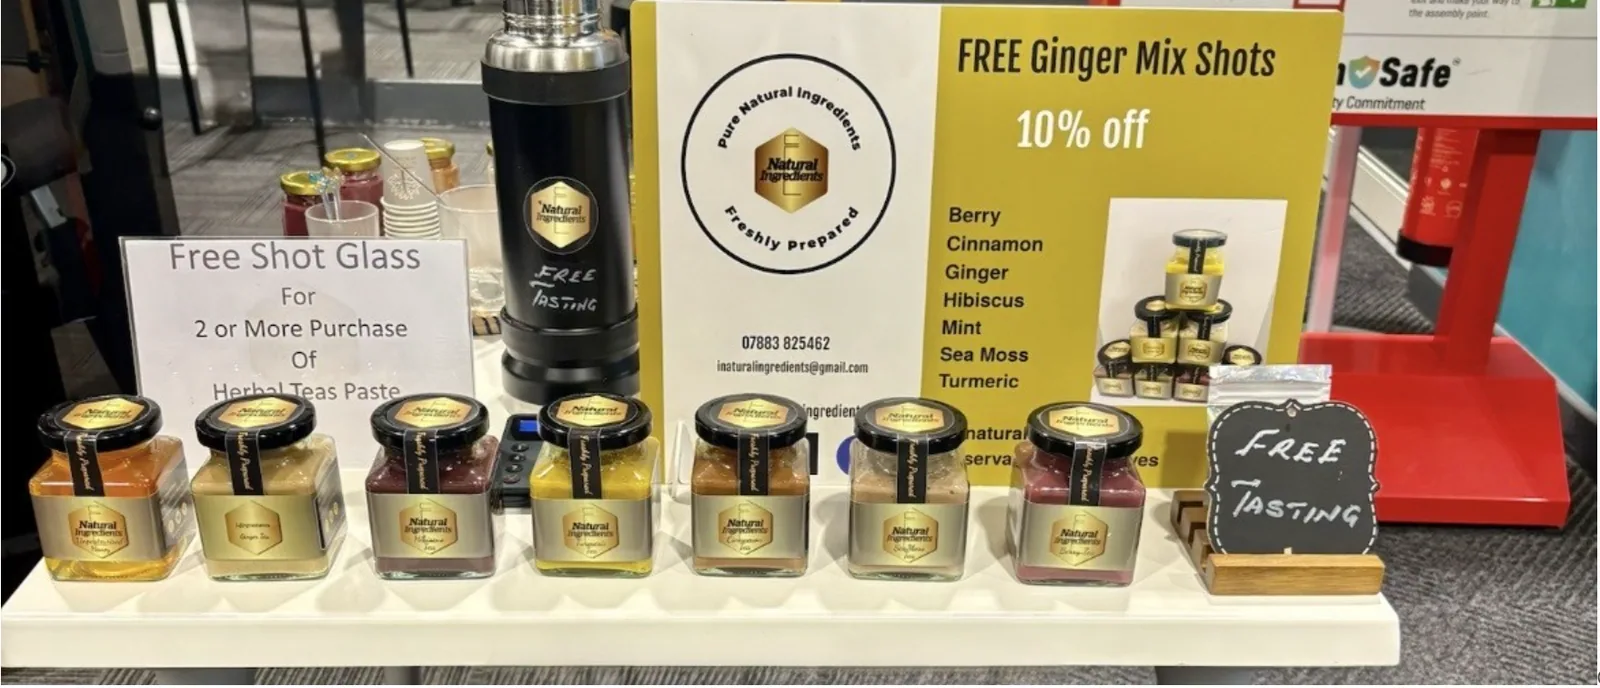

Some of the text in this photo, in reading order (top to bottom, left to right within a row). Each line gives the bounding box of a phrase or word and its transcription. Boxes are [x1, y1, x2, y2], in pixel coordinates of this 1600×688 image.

[1408, 9, 1422, 18] the
[1425, 9, 1465, 20] assembly
[957, 36, 1276, 82] FREE Ginger Mix Shots
[1345, 95, 1426, 110] Commitment
[717, 86, 861, 151] Pure Natural Ingredients
[1016, 108, 1151, 149] 10% off
[767, 158, 818, 171] Natural
[760, 170, 824, 183] Ingredients
[541, 204, 582, 215] Natural
[948, 207, 1001, 226] Berry
[536, 213, 587, 223] Ingredients
[724, 205, 859, 251] Freshly Prepared
[947, 236, 1043, 252] Cinnamon
[169, 241, 421, 270] Free Shot Glass
[534, 265, 597, 283] FREE
[945, 264, 1009, 284] Ginger
[281, 287, 316, 306] For
[529, 280, 598, 312] TASTING
[943, 292, 1024, 308] Hibiscus
[194, 318, 408, 338] 2 or More Purchase
[941, 320, 982, 335] Mint
[742, 336, 830, 350] 07883 825462
[291, 350, 317, 369] Of
[940, 347, 1029, 362] Sea Moss
[717, 360, 868, 375] inaturalingredients@gmail.com
[939, 374, 1019, 388] Turmeric
[289, 383, 337, 400] Teas
[346, 382, 401, 400] Paste
[84, 408, 132, 416] Natural
[413, 406, 460, 414] Natural
[732, 407, 779, 415] Natural
[1061, 415, 1109, 423] Natural
[1235, 429, 1346, 464] FREE
[1231, 479, 1361, 528] TASTING
[78, 520, 117, 530] Natural
[409, 518, 448, 526] Natural
[572, 522, 609, 530] Natural
[727, 519, 764, 527] Natural
[75, 529, 123, 537] Ingredients
[404, 525, 452, 534] Ingredients
[567, 530, 614, 538] Ingredients
[892, 526, 930, 535] Natural
[1060, 529, 1099, 538] Natural
[886, 534, 933, 543] Ingredients
